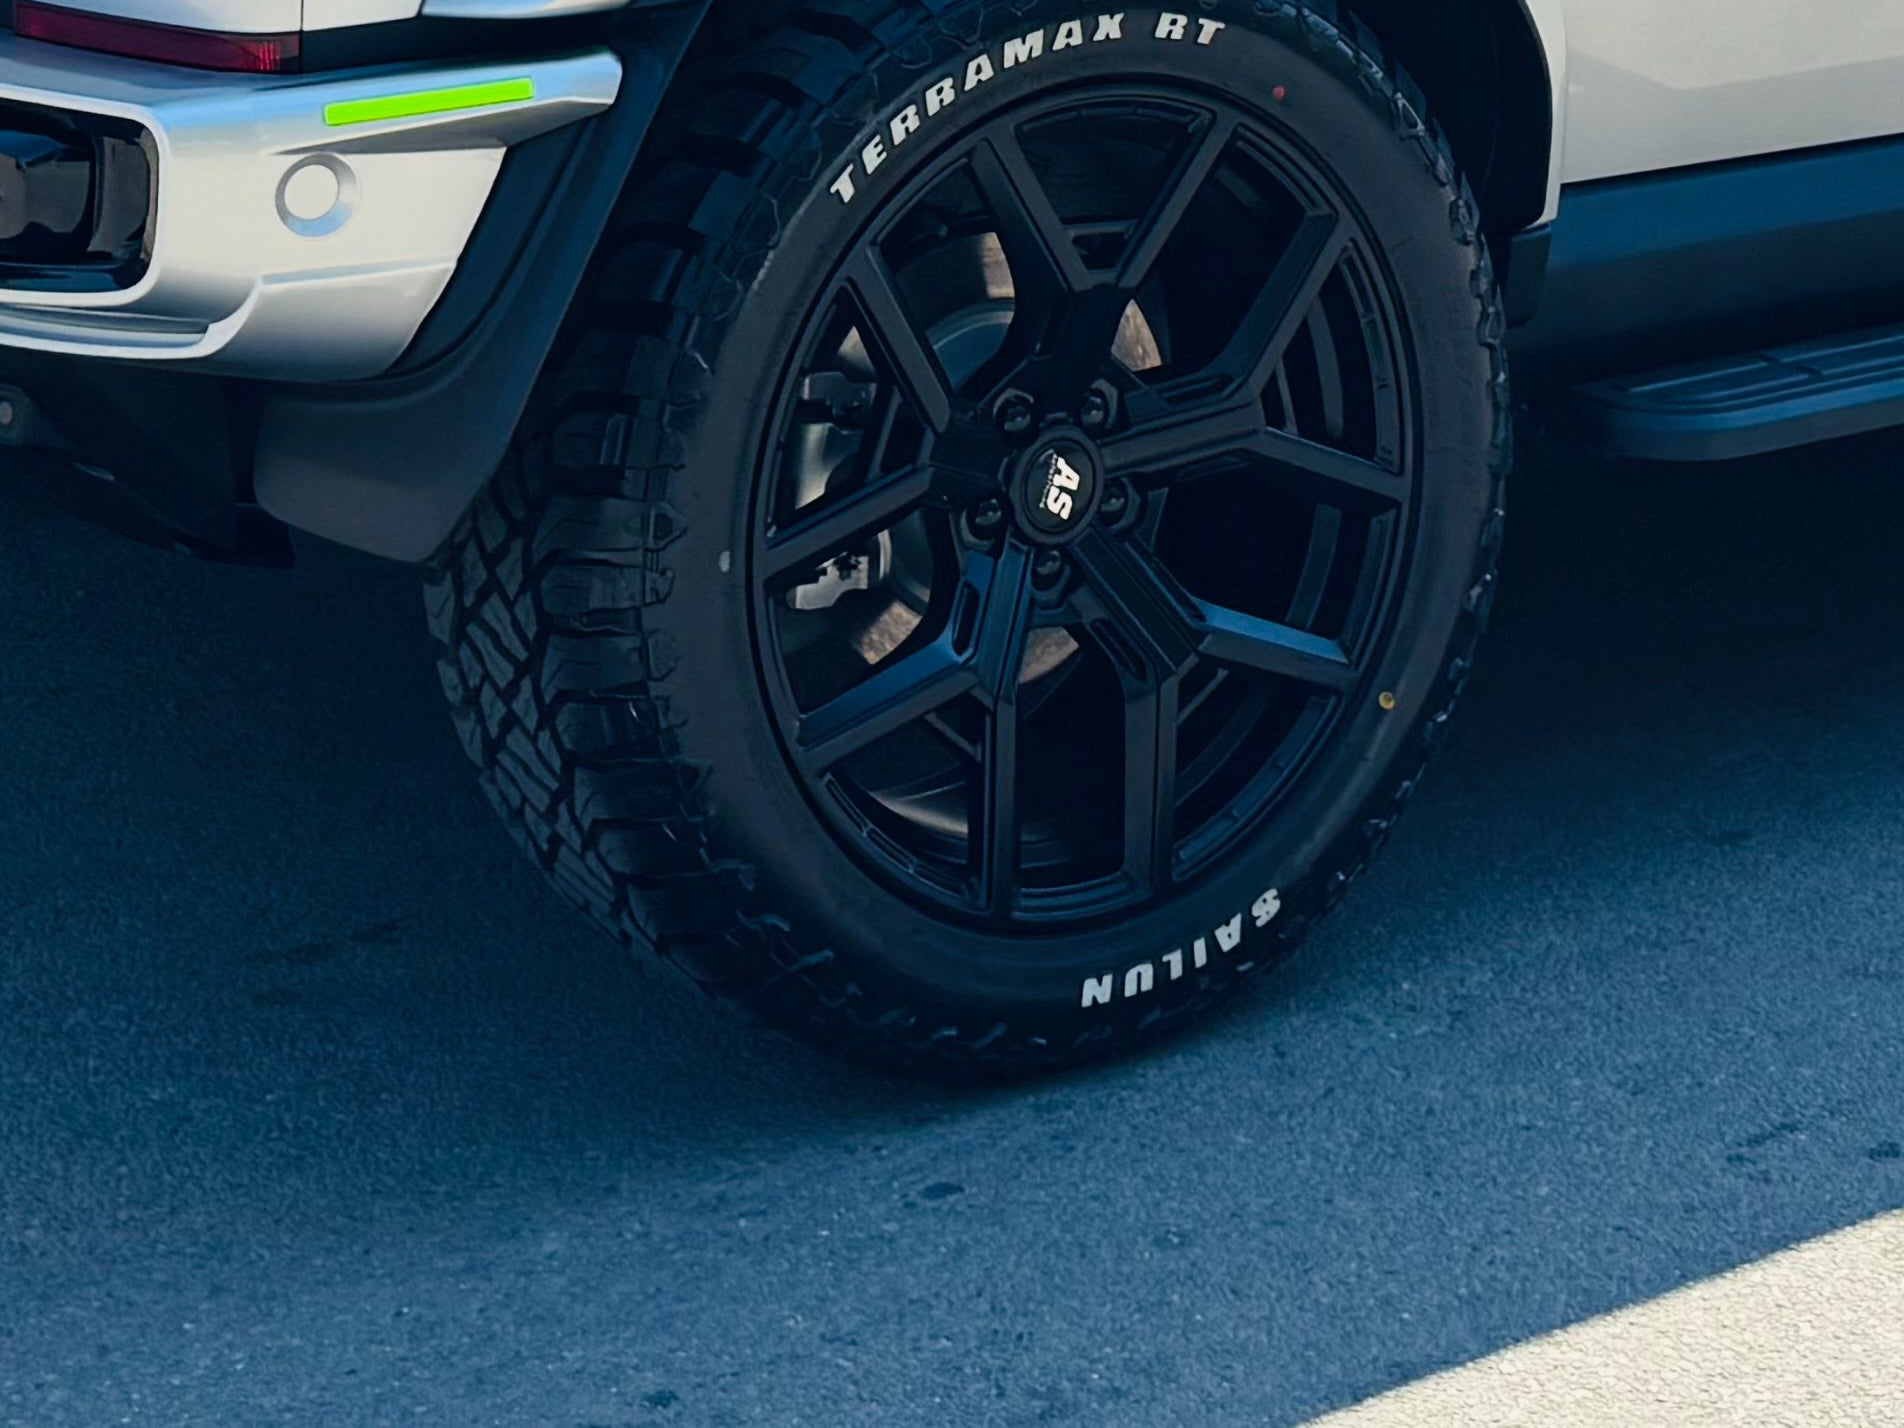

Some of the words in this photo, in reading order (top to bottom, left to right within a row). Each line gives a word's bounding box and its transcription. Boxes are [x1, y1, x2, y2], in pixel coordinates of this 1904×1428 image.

[830, 12, 1125, 204] TERRAMAX
[1155, 12, 1226, 45] RT
[1045, 456, 1081, 521] AS
[1081, 887, 1282, 1009] SAILUN
